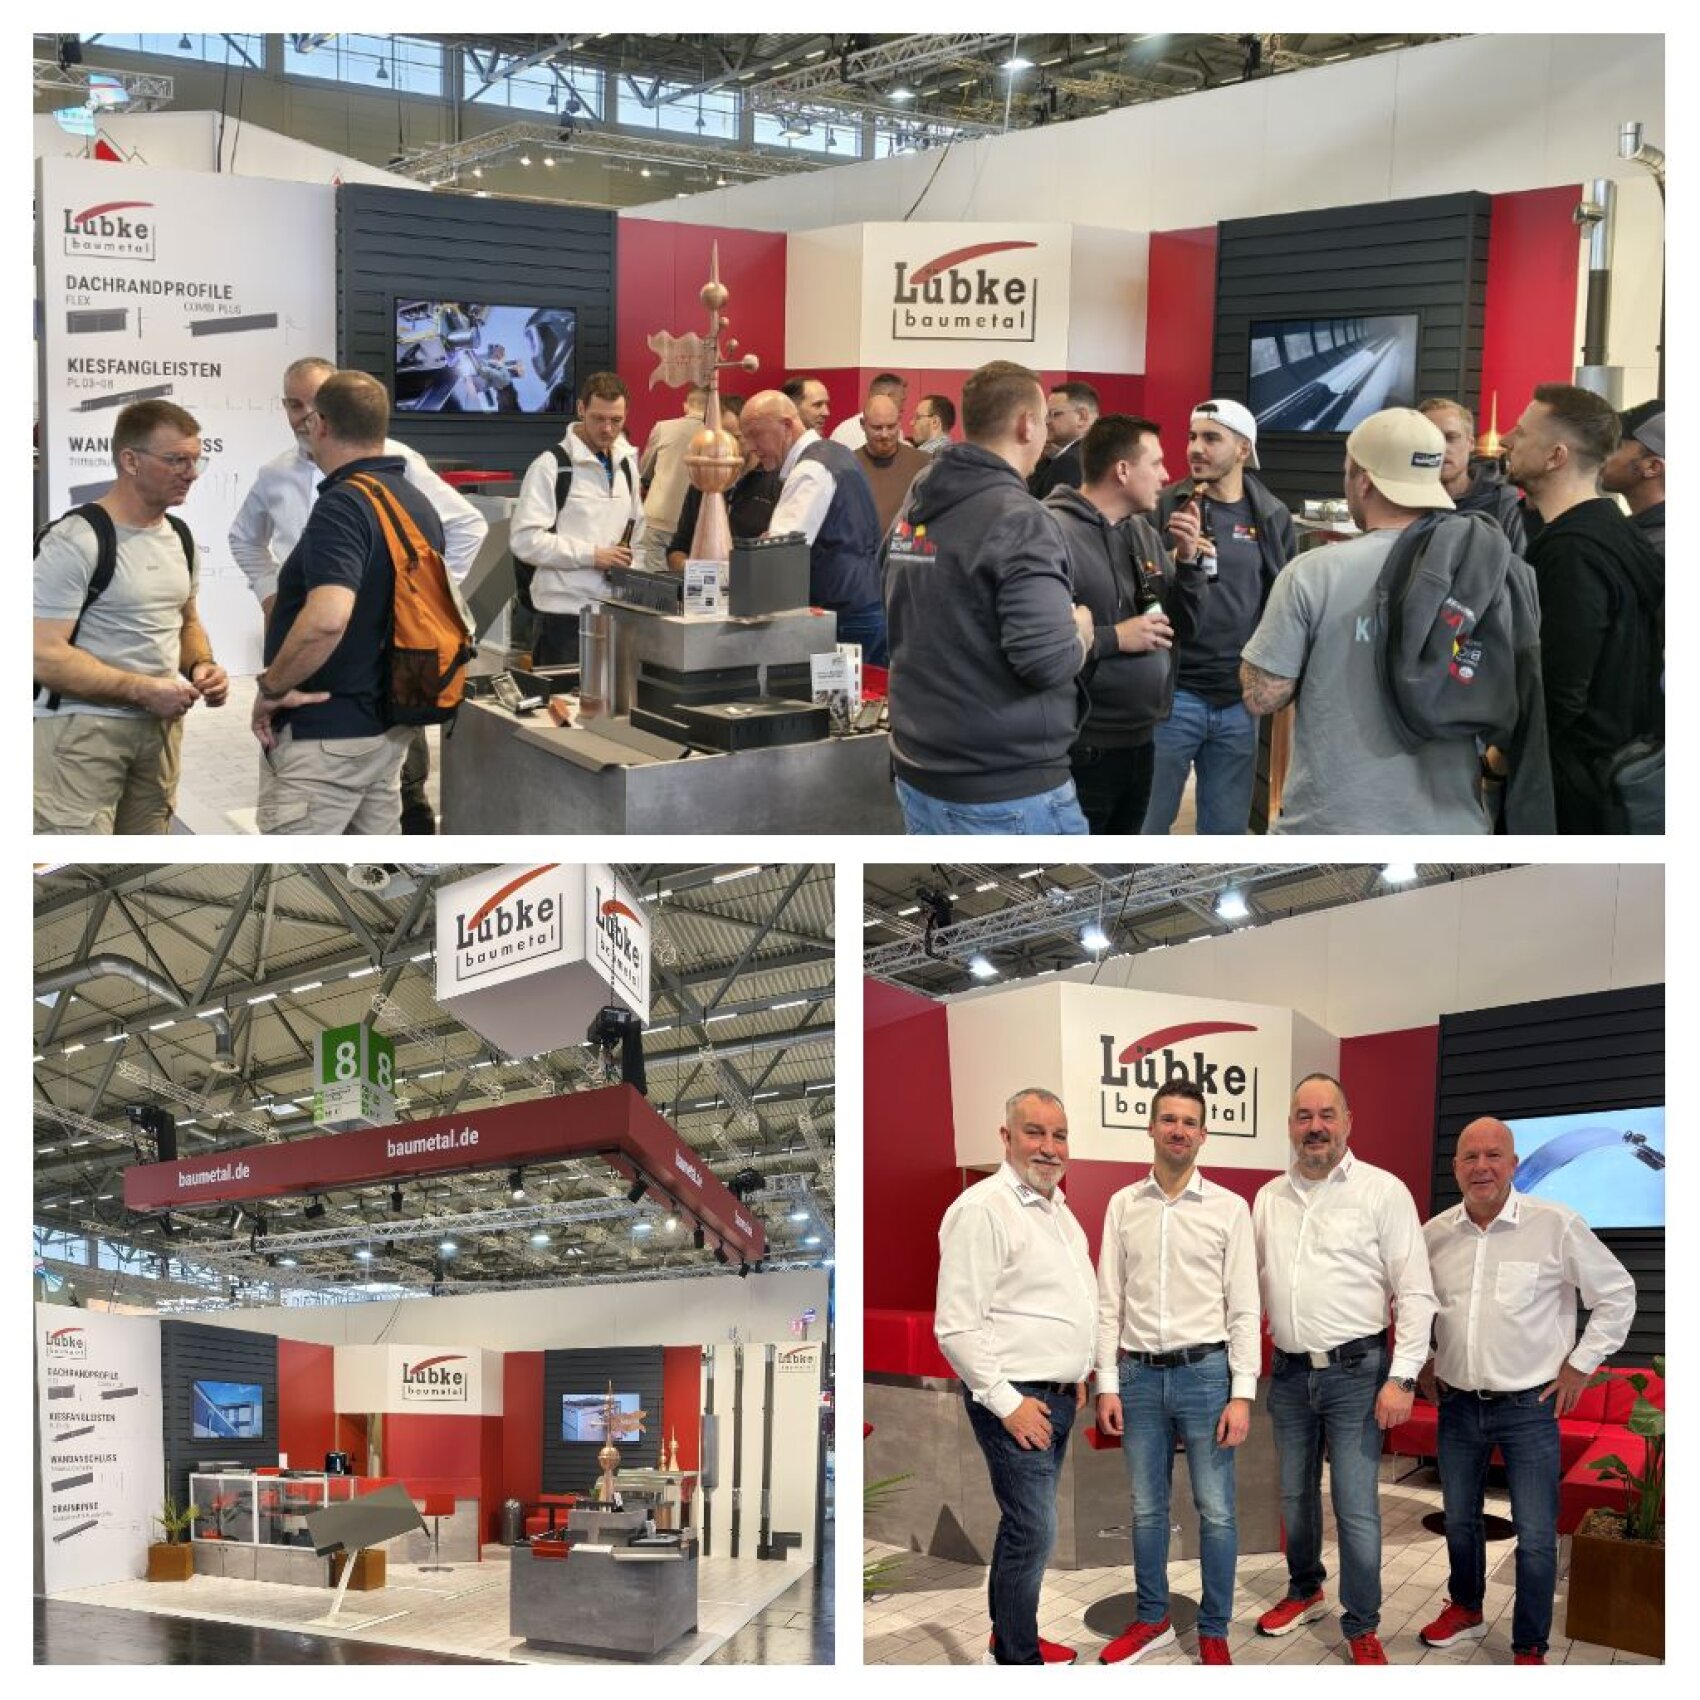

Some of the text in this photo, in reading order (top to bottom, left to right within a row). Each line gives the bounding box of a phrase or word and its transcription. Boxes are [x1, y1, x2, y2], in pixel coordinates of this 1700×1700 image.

[72, 237, 149, 253] baumetal
[65, 274, 233, 300] DACHRANDPROFILE
[65, 293, 91, 306] FLEX
[894, 261, 1027, 306] Lübke
[904, 308, 1025, 329] baumetal
[67, 357, 222, 378] KIESFANGLEISTEN
[456, 896, 554, 950] Lübke
[465, 924, 554, 967] baumetal
[335, 1041, 358, 1081] 8
[377, 1051, 393, 1092] 8
[1100, 1034, 1247, 1096] Lübke
[1115, 1091, 1246, 1123] batal
[387, 1126, 479, 1158] baumetal.de
[178, 1161, 250, 1188] baumetal.de
